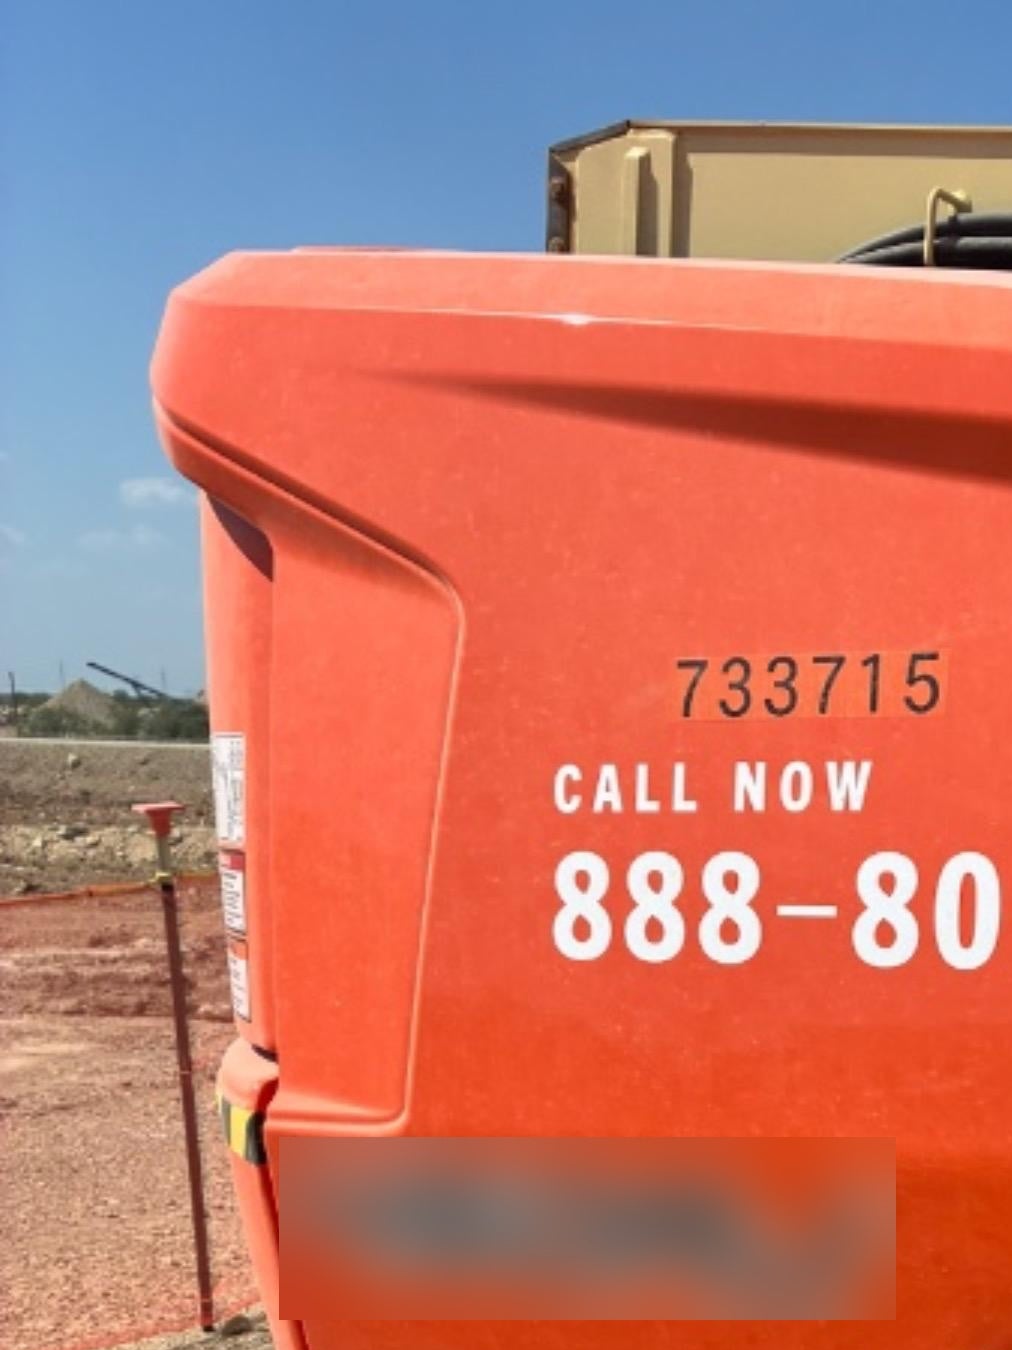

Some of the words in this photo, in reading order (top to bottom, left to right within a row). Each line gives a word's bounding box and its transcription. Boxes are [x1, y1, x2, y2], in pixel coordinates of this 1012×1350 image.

[676, 652, 941, 718] 733715
[553, 762, 698, 813] CALL
[733, 760, 873, 812] NOW
